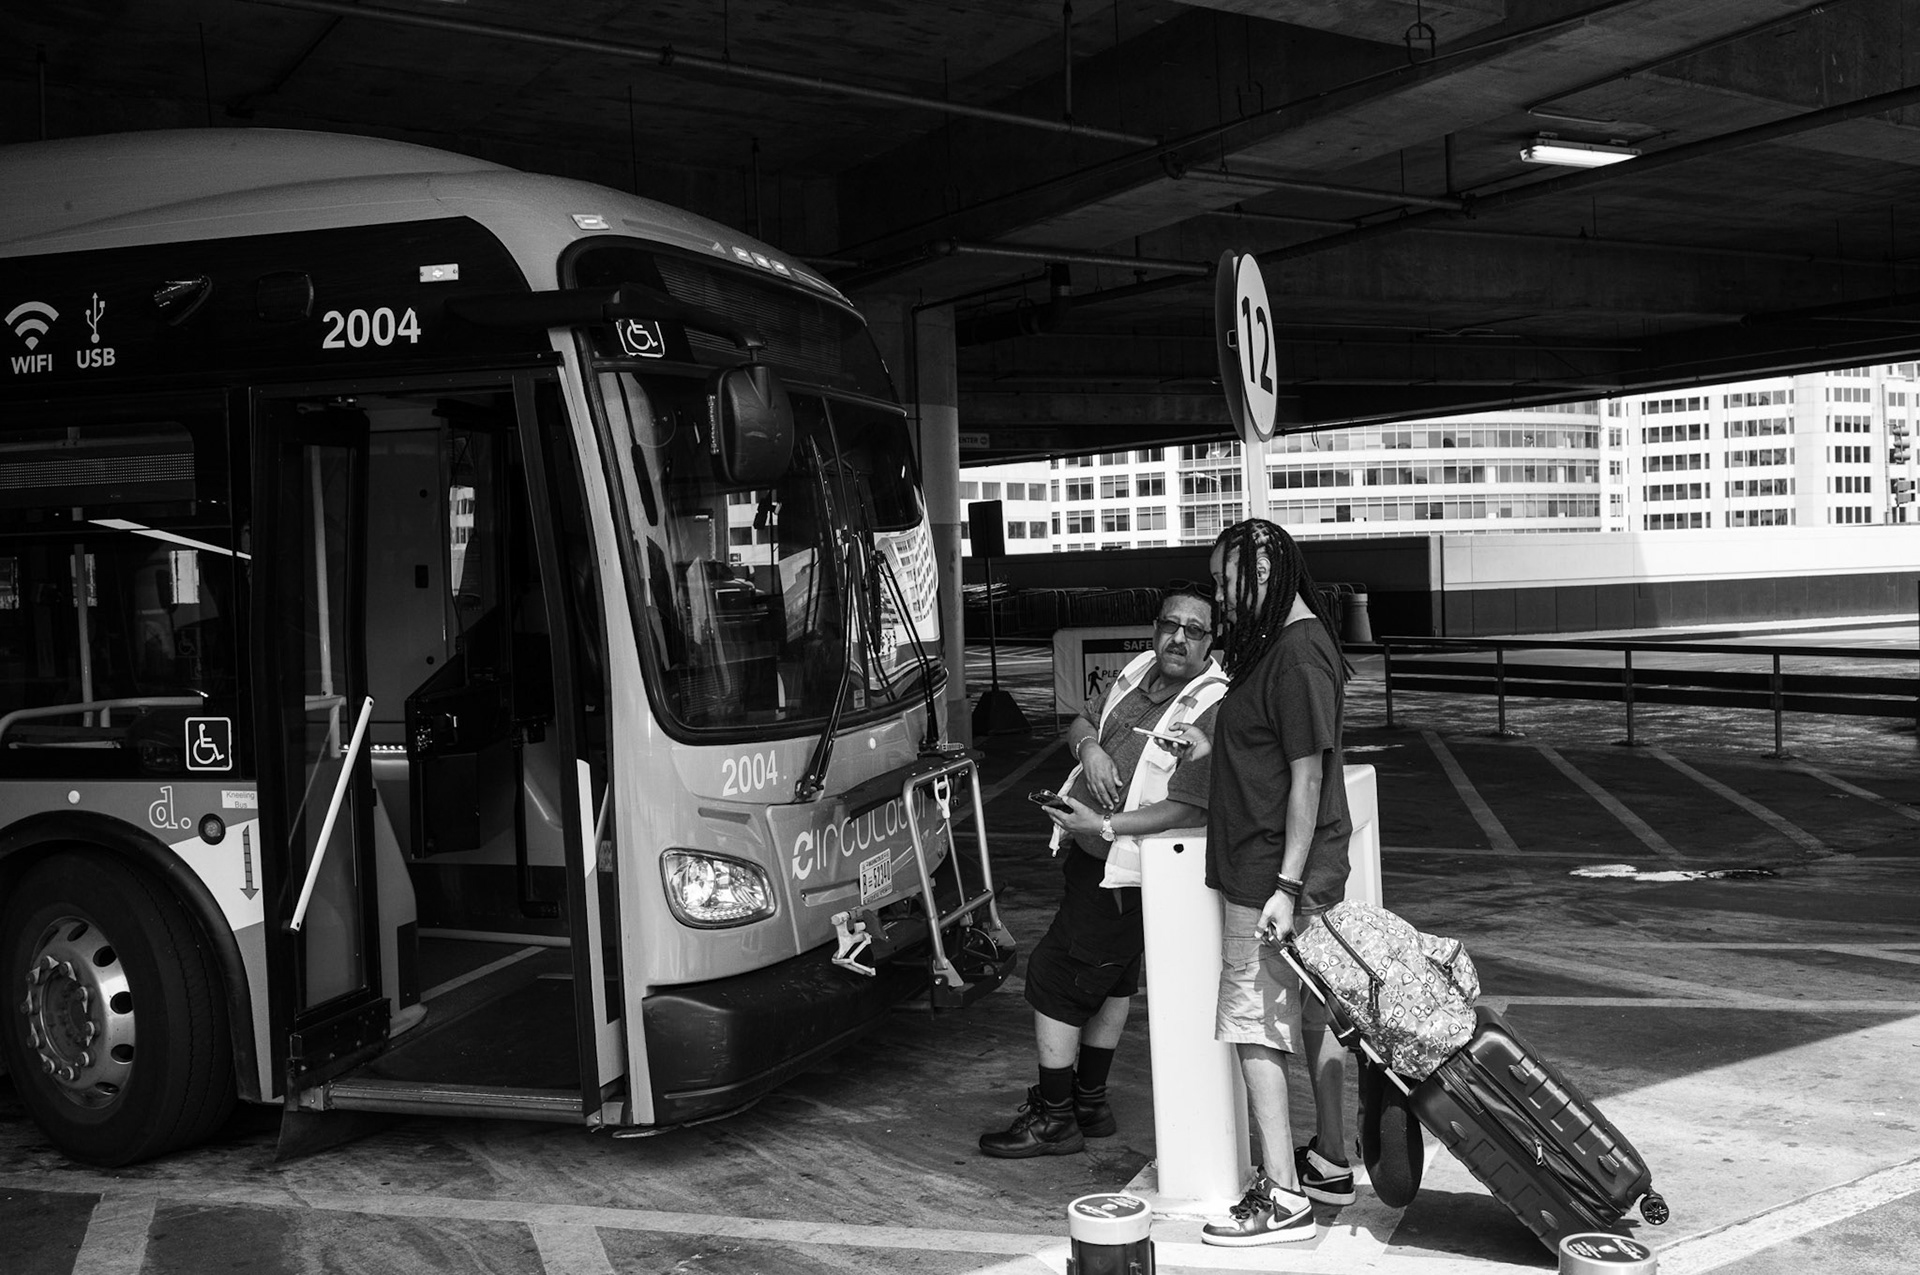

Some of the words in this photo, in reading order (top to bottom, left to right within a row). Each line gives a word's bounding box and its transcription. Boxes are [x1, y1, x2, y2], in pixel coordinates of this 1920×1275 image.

[322, 307, 421, 349] 2004
[76, 347, 116, 369] USB
[1241, 296, 1273, 395] 12
[11, 353, 52, 374] WIFI
[722, 750, 778, 797] 2004
[226, 791, 255, 800] Kneeling
